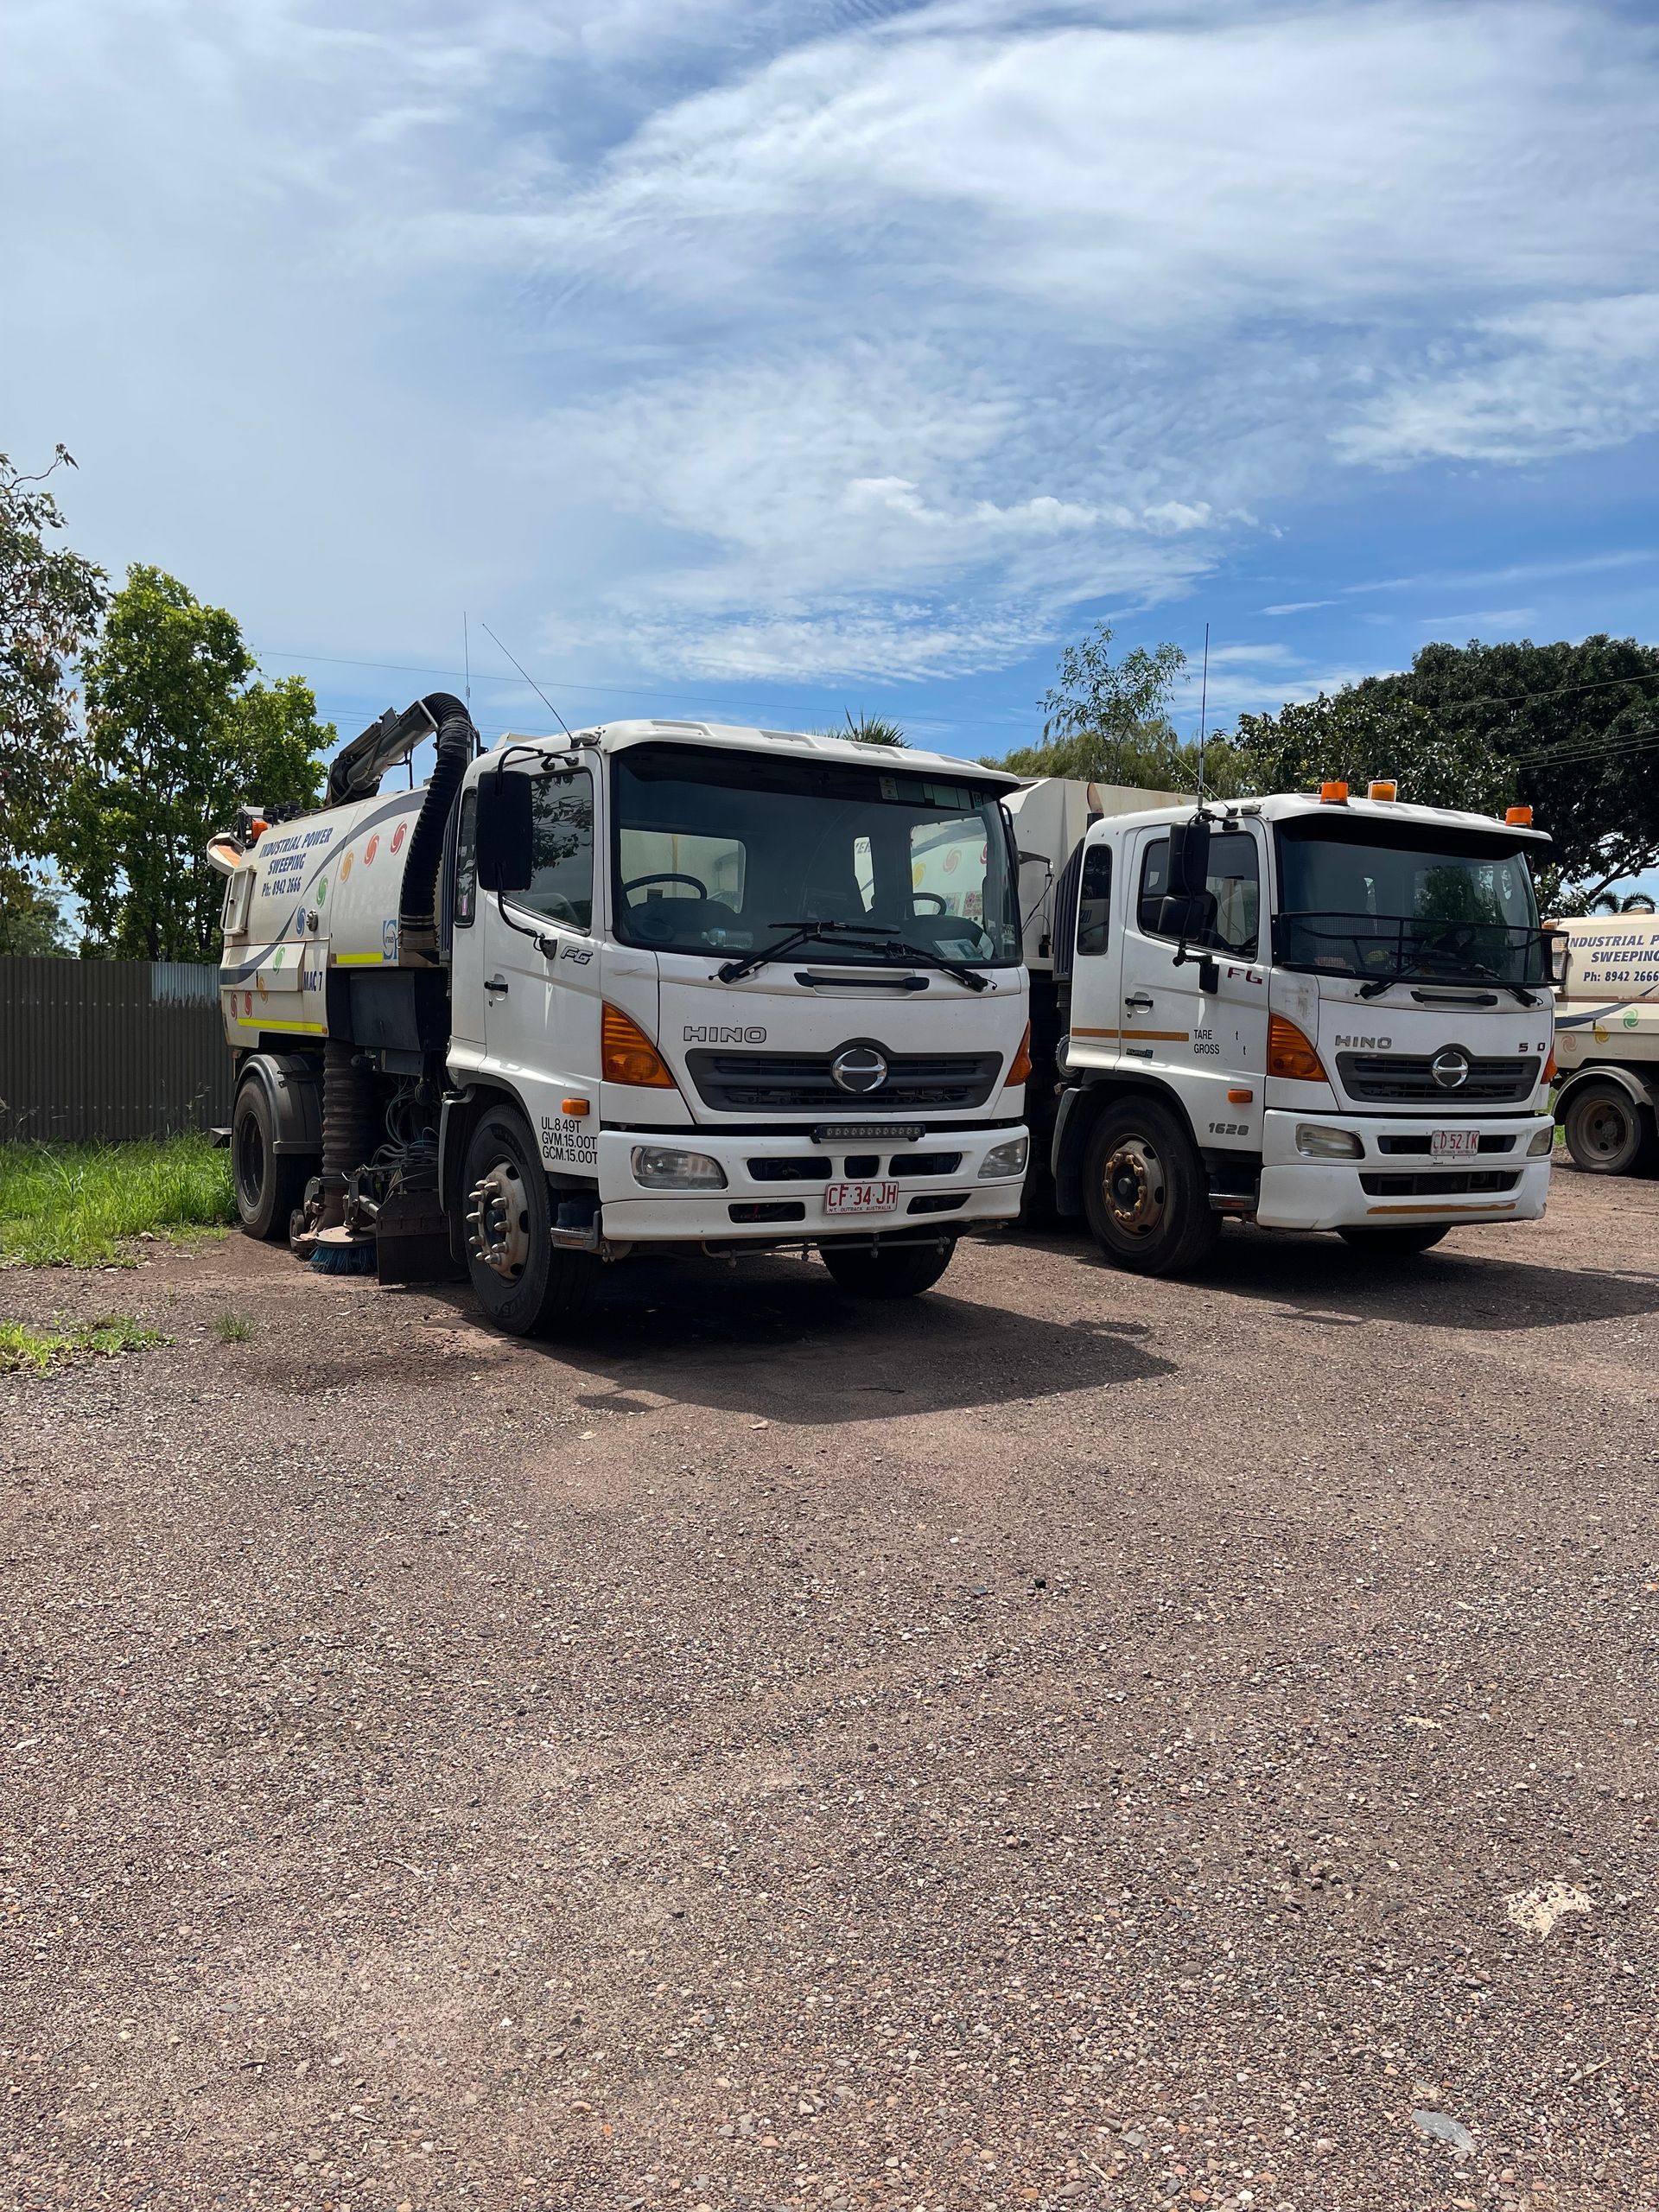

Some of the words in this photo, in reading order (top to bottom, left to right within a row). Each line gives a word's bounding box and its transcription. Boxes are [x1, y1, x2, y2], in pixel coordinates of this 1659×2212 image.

[259, 836, 302, 858] INDUSTRIAL
[302, 828, 334, 849] POWER
[268, 853, 307, 875] SWEEPING
[262, 883, 271, 897] Ph:
[272, 878, 286, 895] 8942
[287, 876, 302, 893] 2666
[1569, 935, 1644, 947] NDUSTRIAL
[560, 945, 594, 965] FG
[303, 970, 317, 991] MAC
[319, 971, 323, 991] 7
[1583, 972, 1601, 982] Ph:
[1605, 971, 1630, 982] 8942
[1634, 971, 1659, 982] 2666
[683, 1026, 767, 1044] HINO
[1193, 1029, 1213, 1040] TARE
[1236, 1030, 1239, 1040] t
[1335, 1034, 1393, 1050] HINO
[1193, 1043, 1220, 1055] GROSS
[1243, 1045, 1246, 1056] t
[1518, 1042, 1529, 1053] 5
[1209, 1122, 1249, 1136] 1628
